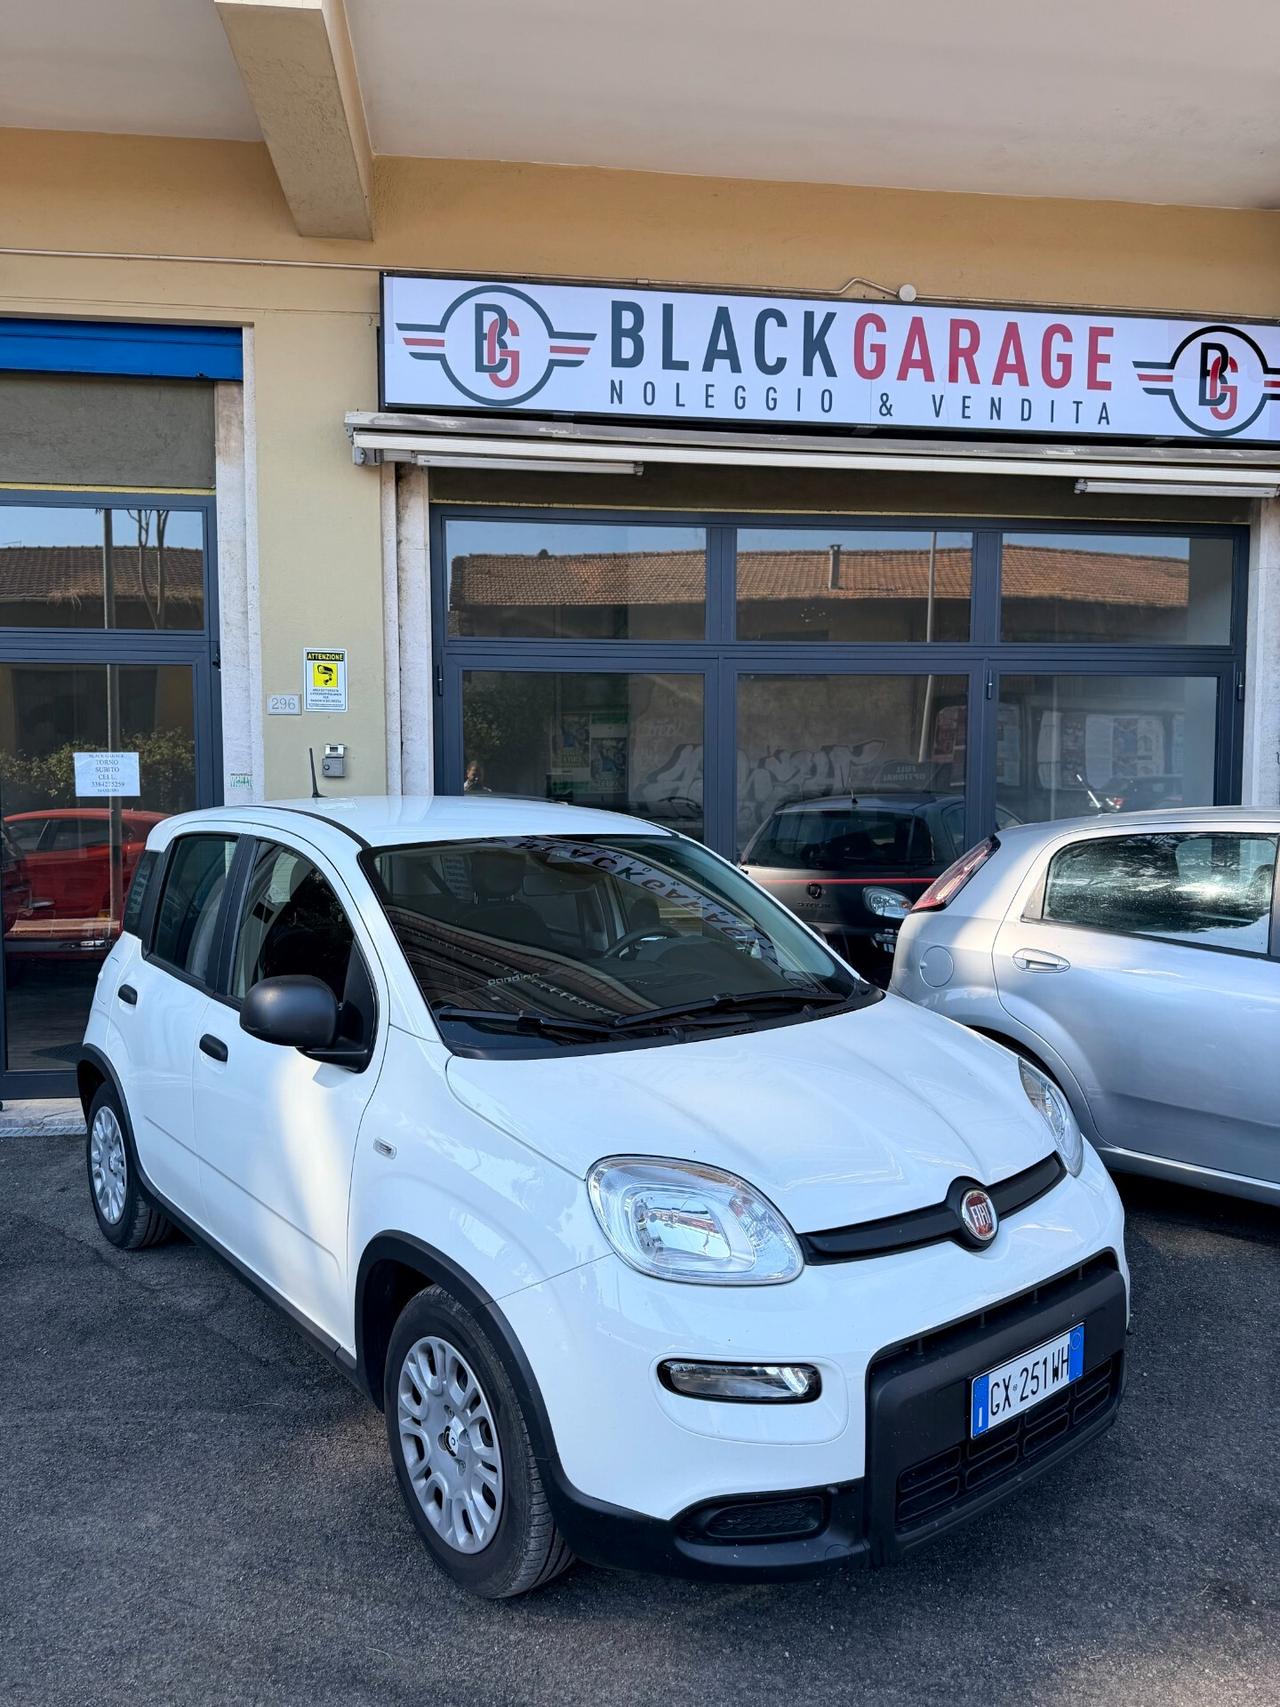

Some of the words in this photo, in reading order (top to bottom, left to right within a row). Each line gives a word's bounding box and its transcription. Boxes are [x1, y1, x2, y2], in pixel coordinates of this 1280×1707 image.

[610, 379, 833, 413] NOLEGGIO
[878, 393, 893, 417] &
[931, 395, 1111, 426] VENDITA
[271, 697, 296, 710] 296
[970, 1202, 992, 1228] FIAT
[990, 1374, 1012, 1416] GX
